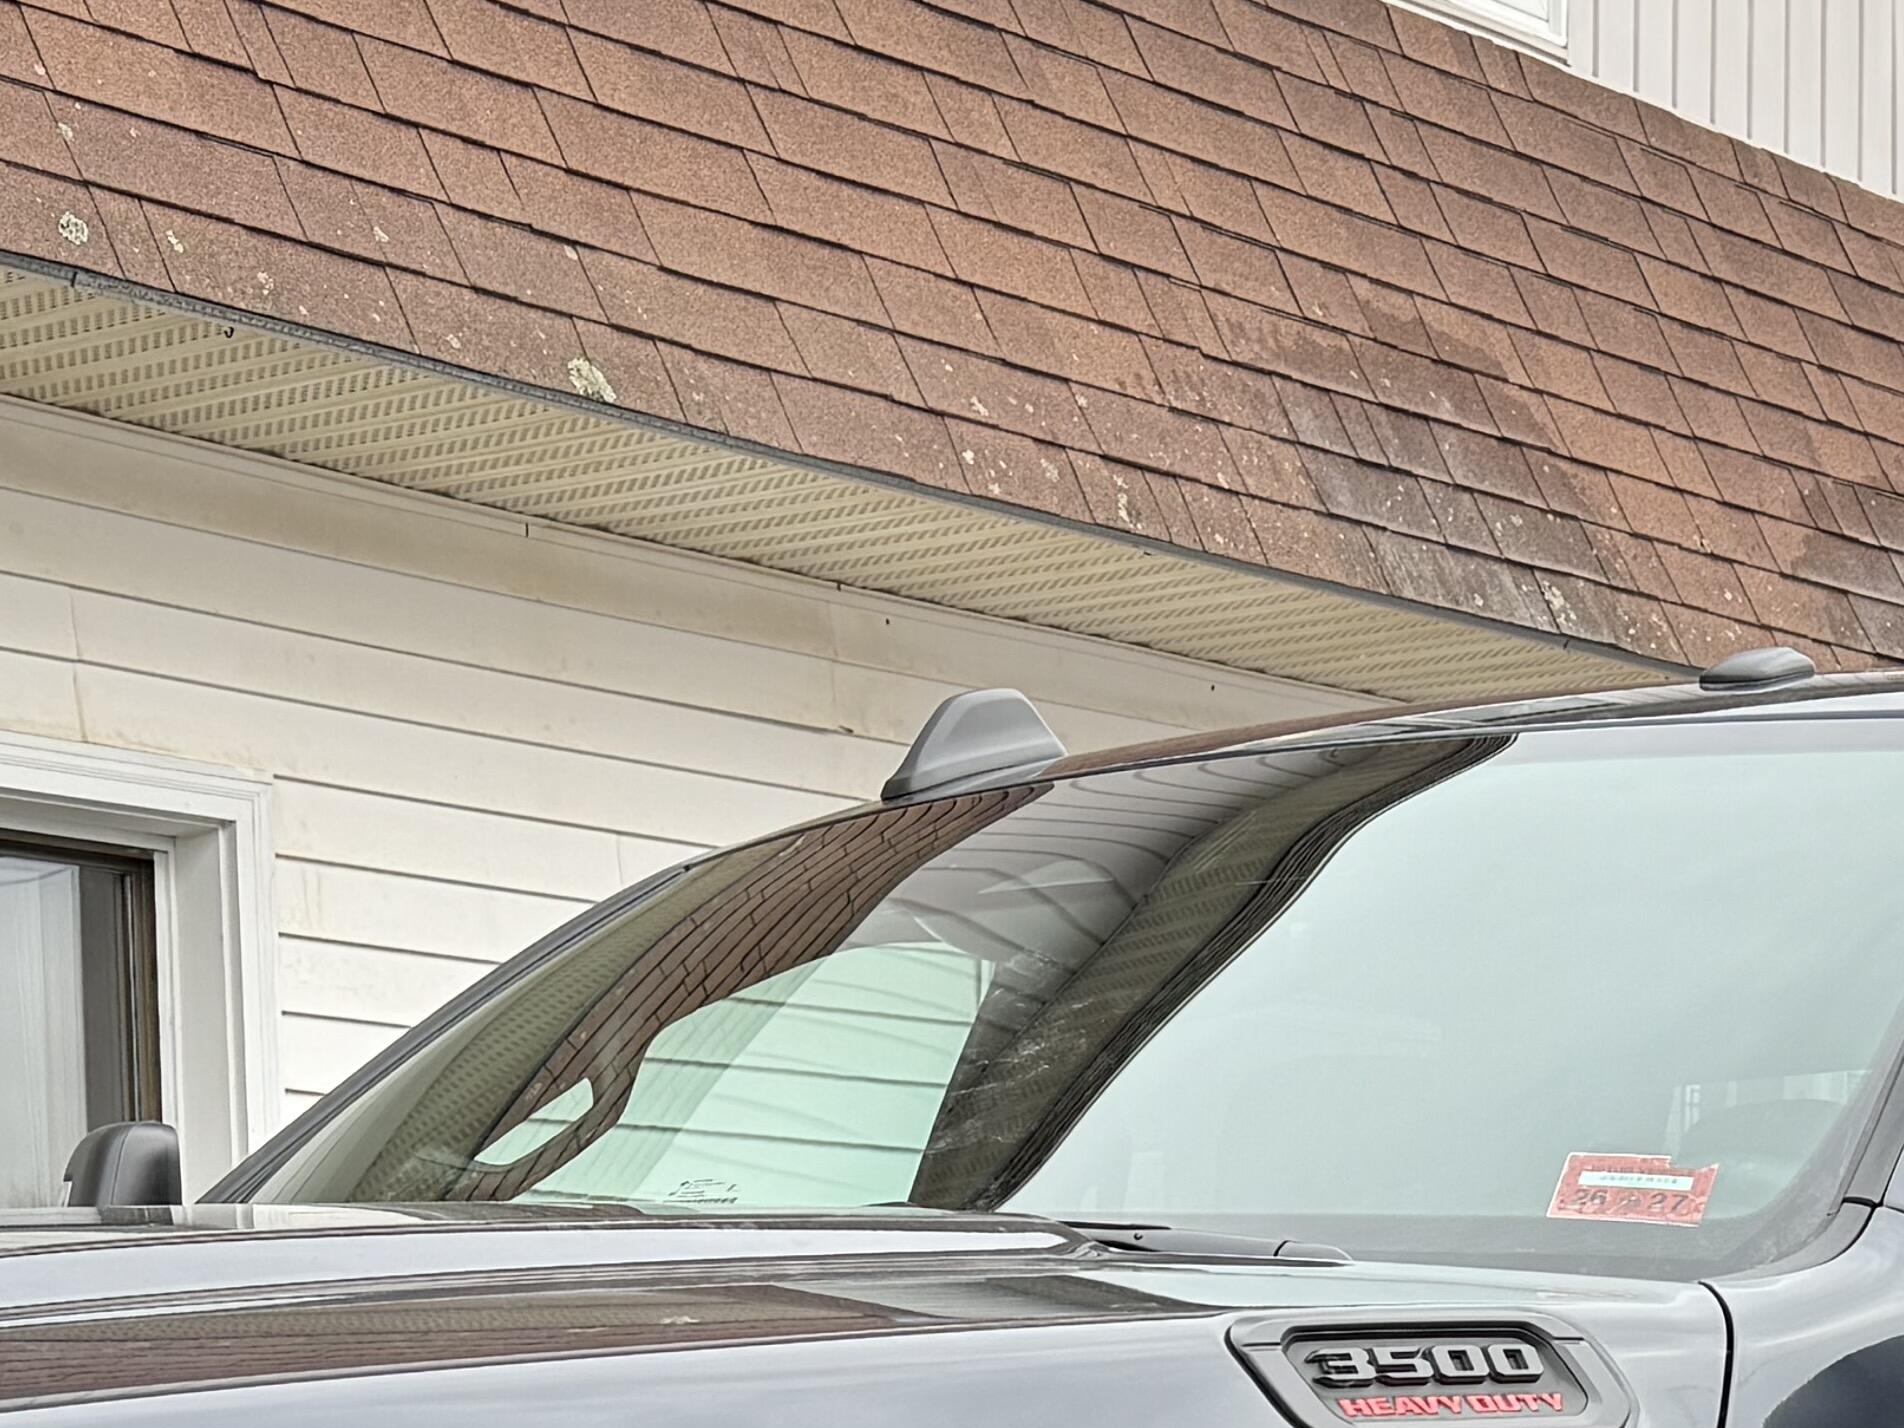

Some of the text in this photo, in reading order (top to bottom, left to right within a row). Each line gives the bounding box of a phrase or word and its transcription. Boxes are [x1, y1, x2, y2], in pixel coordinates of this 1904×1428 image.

[1303, 1343, 1545, 1390] 3500
[1337, 1392, 1564, 1418] HEAVY DUTY
